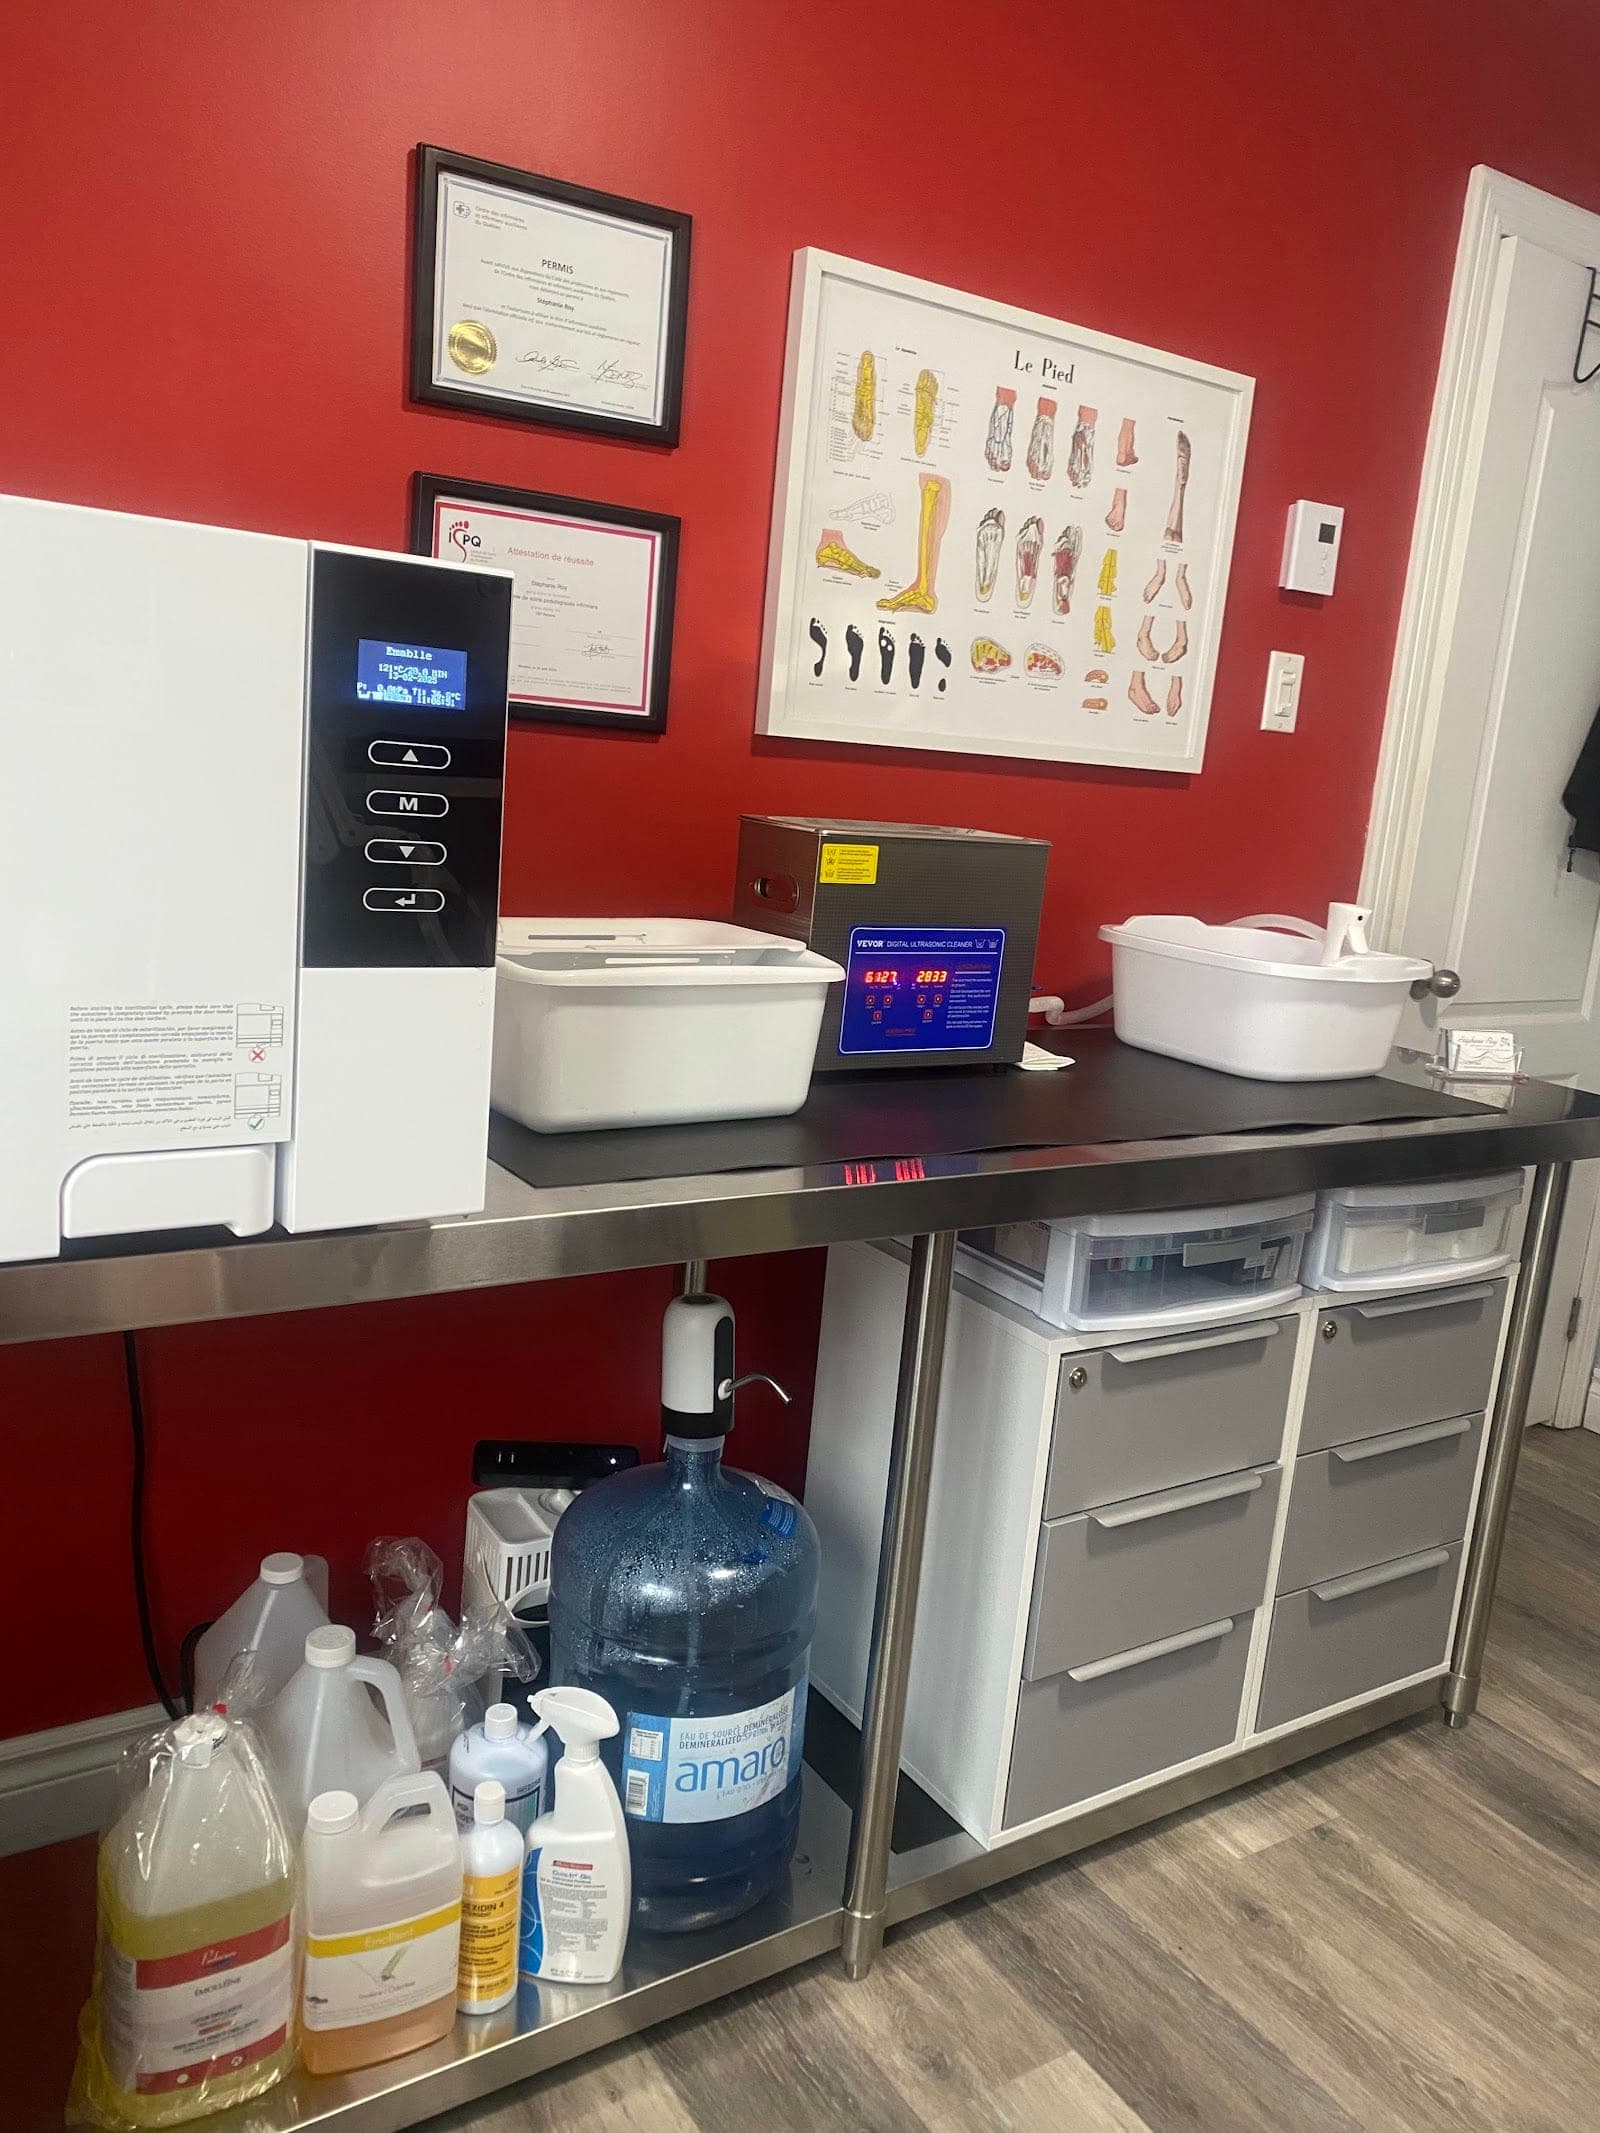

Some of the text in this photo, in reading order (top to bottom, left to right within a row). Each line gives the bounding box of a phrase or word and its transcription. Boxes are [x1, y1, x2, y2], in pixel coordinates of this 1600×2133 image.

[541, 258, 574, 275] PERMIS
[1014, 350, 1075, 384] Le Pied
[507, 546, 550, 560] Attestation
[551, 552, 562, 562] de
[563, 553, 594, 567] réussite
[399, 796, 418, 812] M
[857, 940, 884, 948] VEVOR
[947, 941, 973, 949] CLEANER
[680, 1732, 696, 1741] EAU
[699, 1731, 709, 1740] DE
[680, 1734, 742, 1749] DEMINERALIZED
[675, 1736, 786, 1792] amaro
